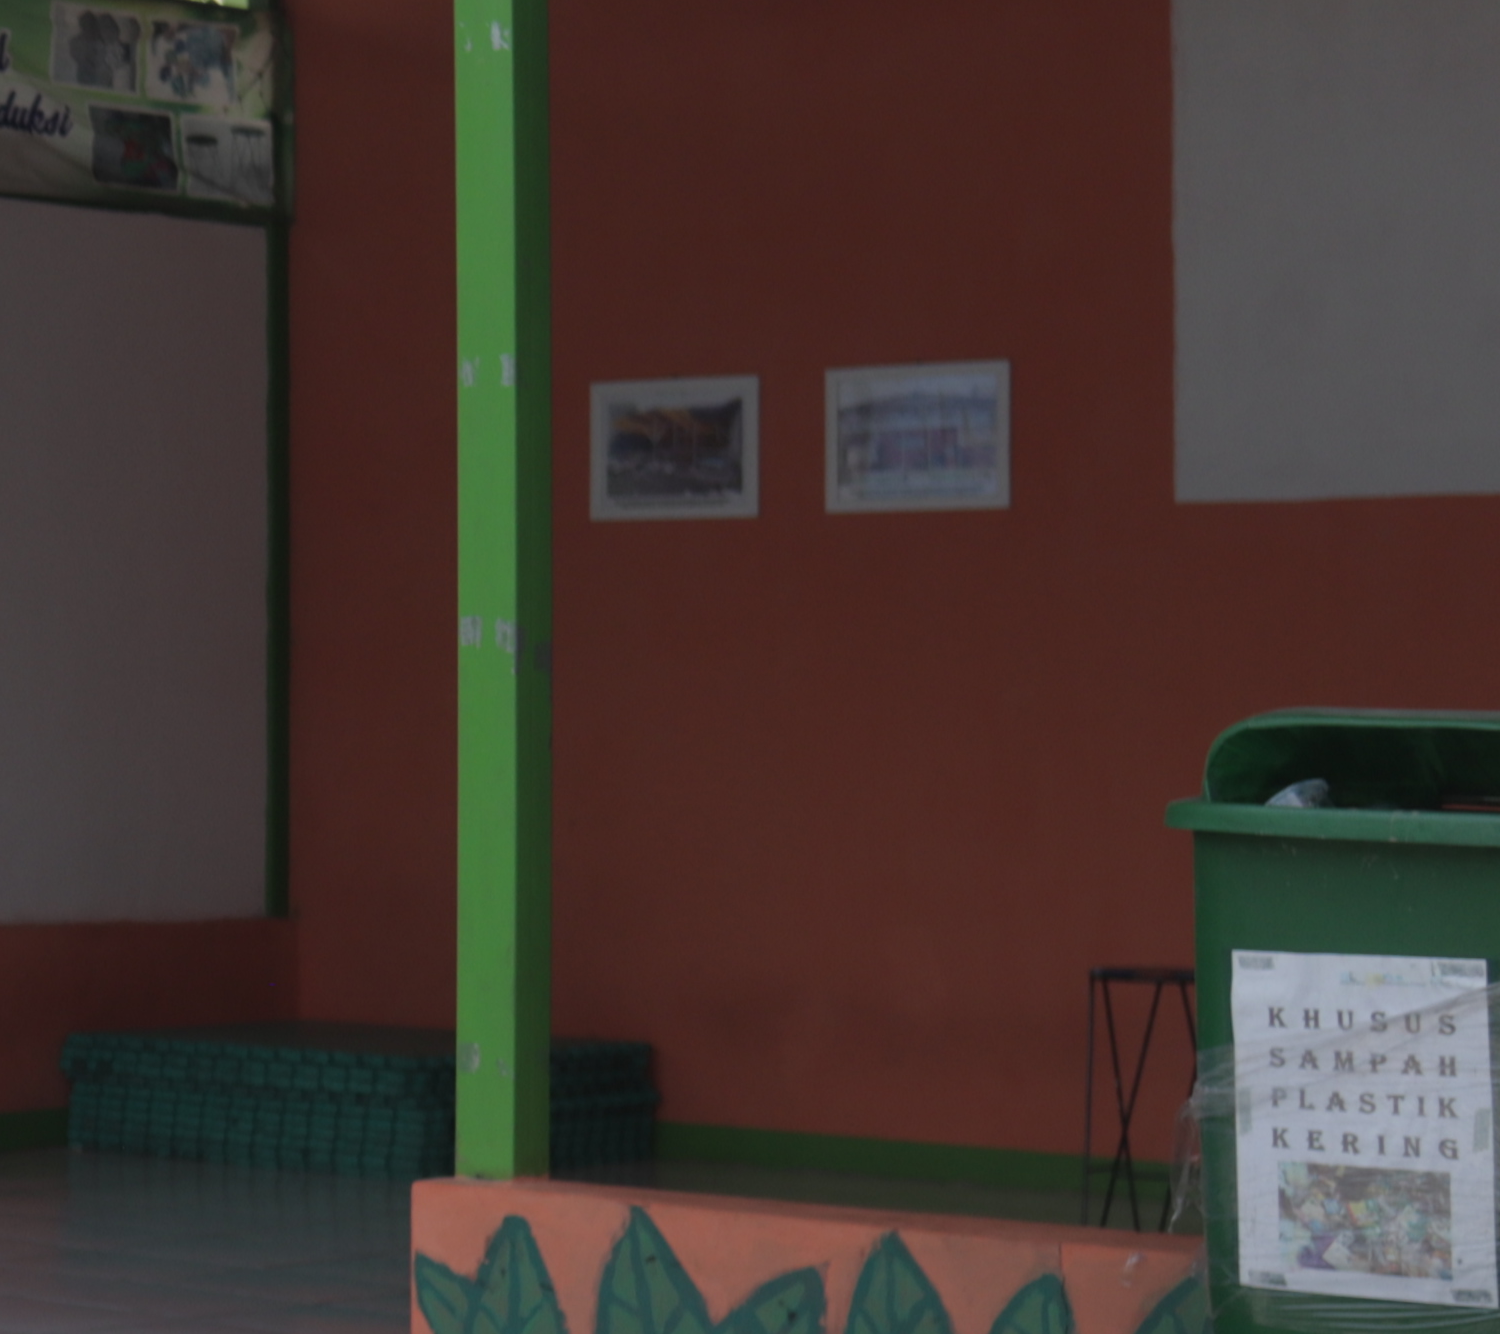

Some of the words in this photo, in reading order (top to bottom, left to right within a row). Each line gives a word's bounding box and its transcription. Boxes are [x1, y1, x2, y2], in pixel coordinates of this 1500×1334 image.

[1267, 1005, 1458, 1037] KHUSUS
[1268, 1045, 1458, 1079] SAMPAH
[1271, 1087, 1458, 1120] PLASTIK
[1272, 1126, 1460, 1162] KERING
